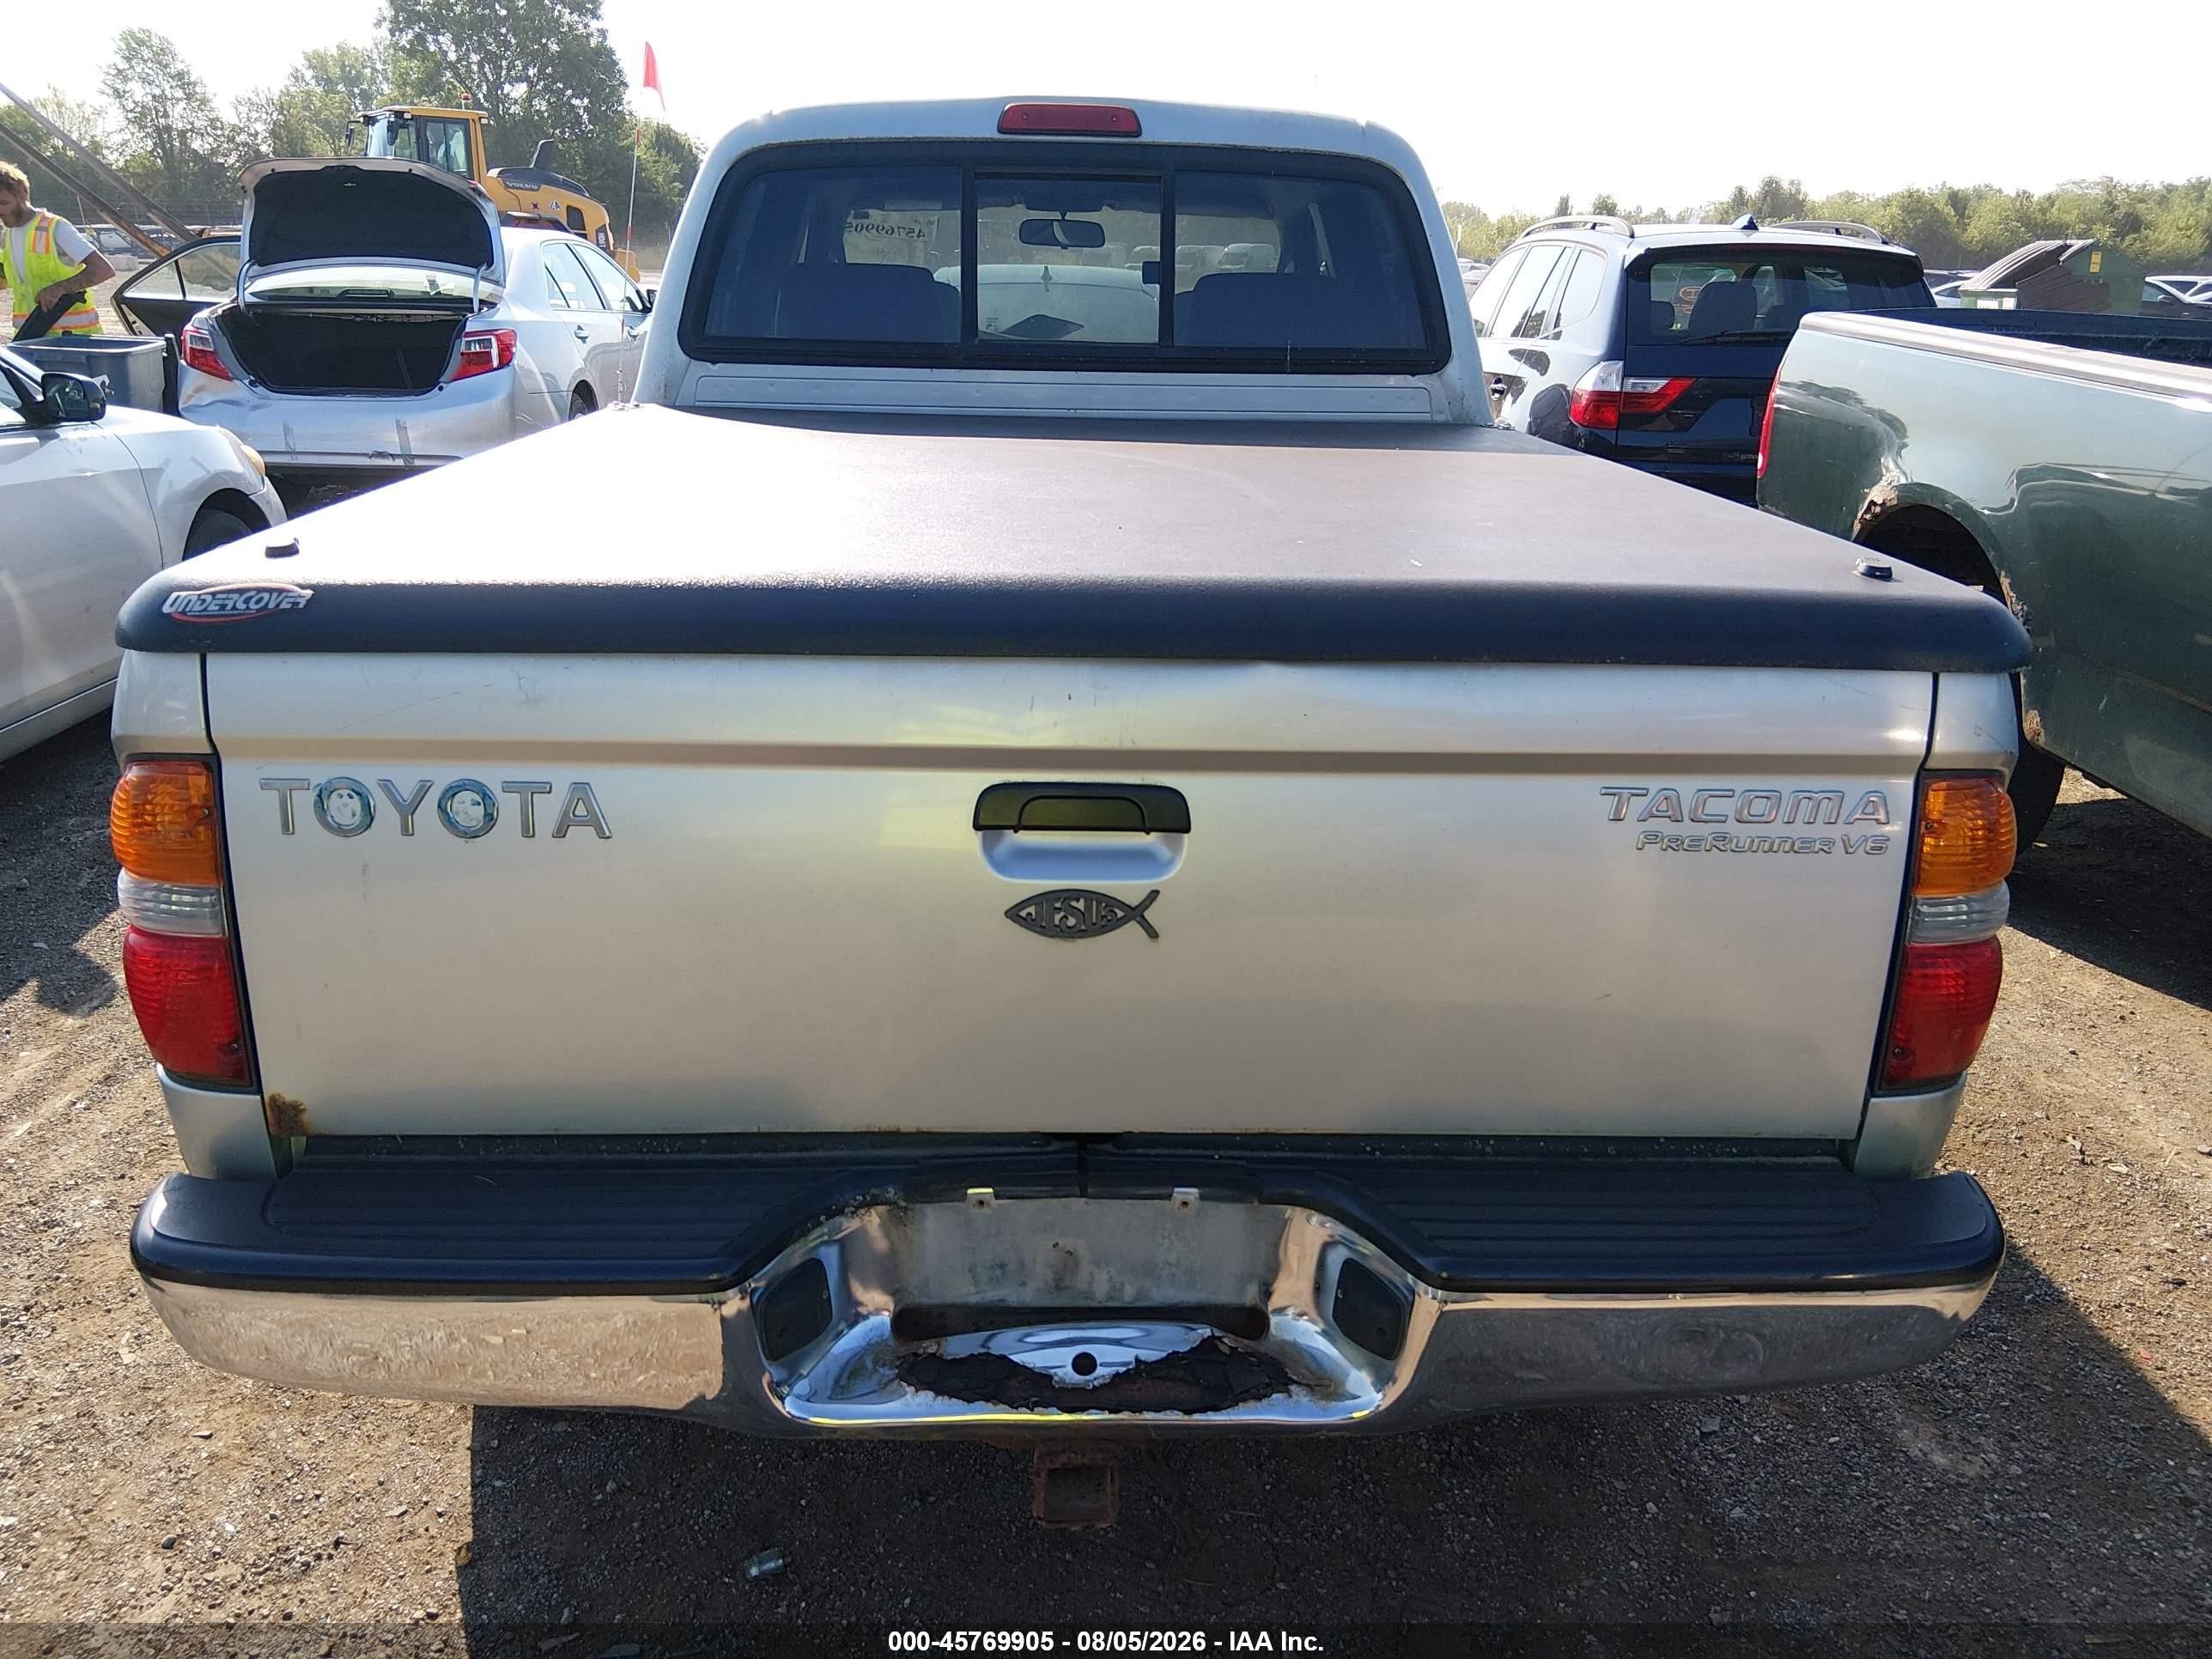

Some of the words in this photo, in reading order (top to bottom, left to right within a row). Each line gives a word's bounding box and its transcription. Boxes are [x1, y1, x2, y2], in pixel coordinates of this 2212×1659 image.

[506, 181, 538, 190] VOLVO
[161, 589, 315, 614] UNDERCOVER
[259, 776, 613, 839] TOYOTA
[1600, 787, 1890, 825] TACOMA
[1841, 833, 1890, 856] V6
[1024, 898, 1119, 933] JESUS
